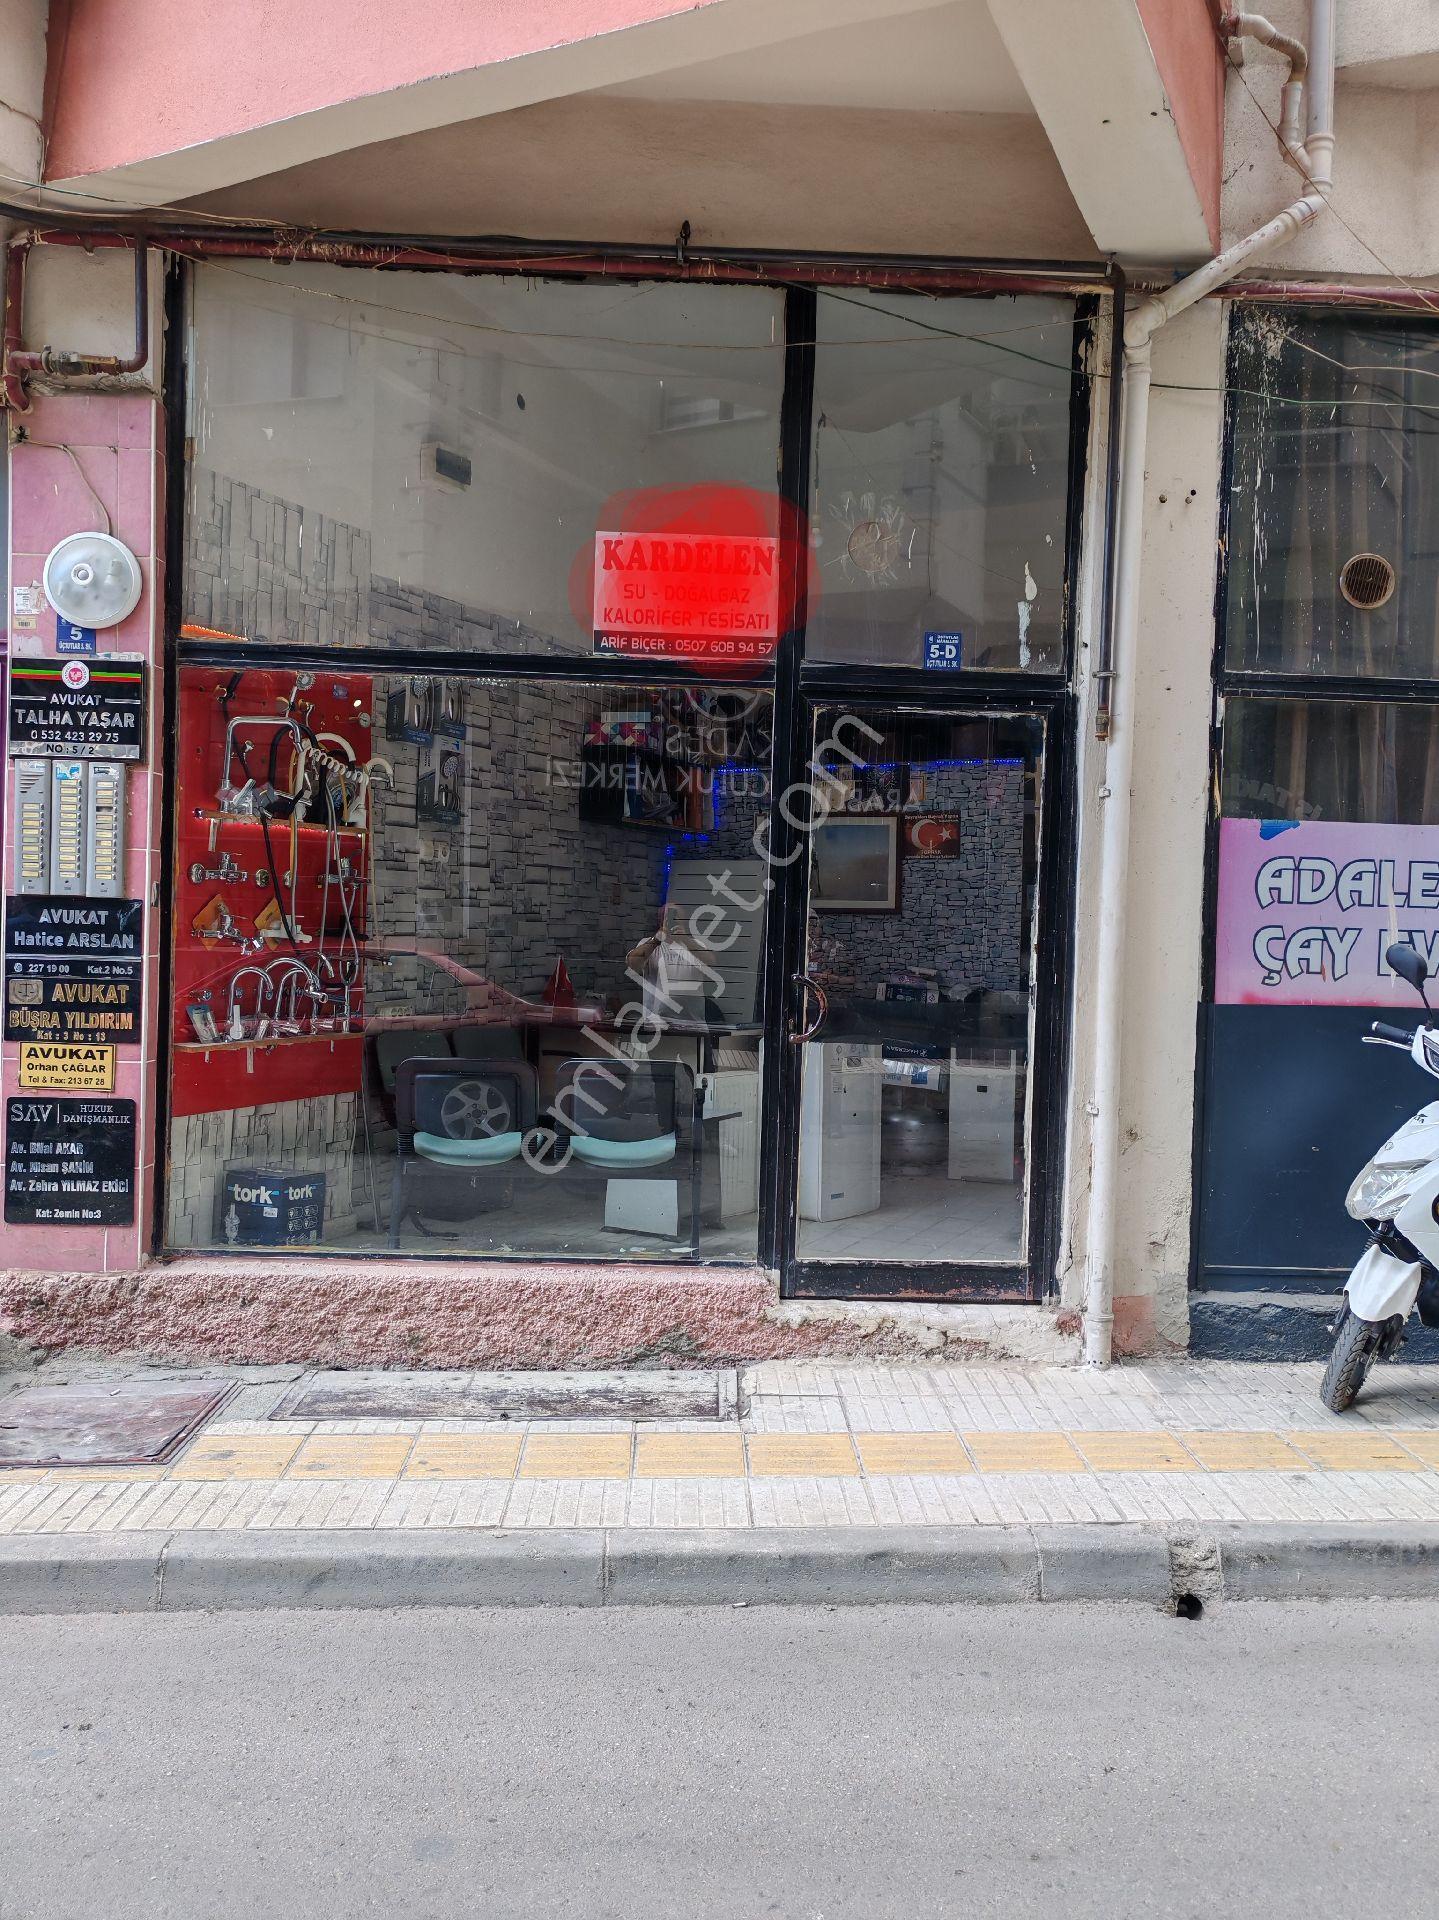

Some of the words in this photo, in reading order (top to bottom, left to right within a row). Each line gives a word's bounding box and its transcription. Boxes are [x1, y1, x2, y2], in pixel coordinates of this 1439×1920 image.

[603, 540, 775, 576] KARDELEN
[623, 584, 646, 600] SU
[603, 606, 692, 627] KALORİFER
[700, 610, 770, 630] TESİSATI
[70, 627, 82, 640] 5
[600, 635, 628, 649] ARİF
[631, 636, 665, 653] BİÇER
[675, 640, 706, 652] 0507
[710, 641, 735, 652] 608
[738, 643, 755, 654] 94
[758, 643, 774, 654] 57
[930, 644, 957, 659] 5-D
[50, 693, 102, 706] AVUKAT
[15, 708, 73, 726] TALHA
[77, 711, 135, 728] YAŞAR
[30, 729, 38, 740] 0
[41, 730, 61, 740] 532
[65, 731, 85, 741] 423
[88, 732, 102, 742] 29
[105, 733, 119, 743] 75
[46, 744, 63, 753] NO
[88, 747, 95, 755] 2
[39, 908, 109, 925] AVUKAT
[14, 931, 64, 947] Hatice
[67, 932, 134, 949] ARSLAN
[1253, 925, 1363, 986] ÇAY
[28, 963, 45, 973] 227
[47, 964, 57, 973] 19
[58, 964, 70, 973] 00
[51, 983, 130, 1004] AVUKAT
[9, 1006, 61, 1031] BÜŞRA
[65, 1011, 133, 1030] YILDIRIM
[63, 1031, 69, 1040] 3
[73, 1031, 84, 1041] No
[25, 1047, 108, 1061] AVUKAT
[27, 1062, 58, 1072] Orhan
[61, 1062, 106, 1073] ÇAĞLAR
[28, 1075, 39, 1083] Tel
[50, 1076, 66, 1084] Fax:
[68, 1077, 82, 1085] 213
[95, 1078, 105, 1086] 28
[80, 1104, 114, 1113] HUKUK
[63, 1114, 131, 1125] DANIŞMANLIK
[10, 1141, 27, 1154] Av.
[10, 1161, 27, 1173] Av.
[9, 1179, 26, 1191] Av.
[28, 1180, 59, 1192] Zehra
[60, 1180, 100, 1192] YILMAZ
[288, 1184, 313, 1200] tork
[233, 1184, 272, 1205] tork
[53, 1209, 80, 1218] Zemin
